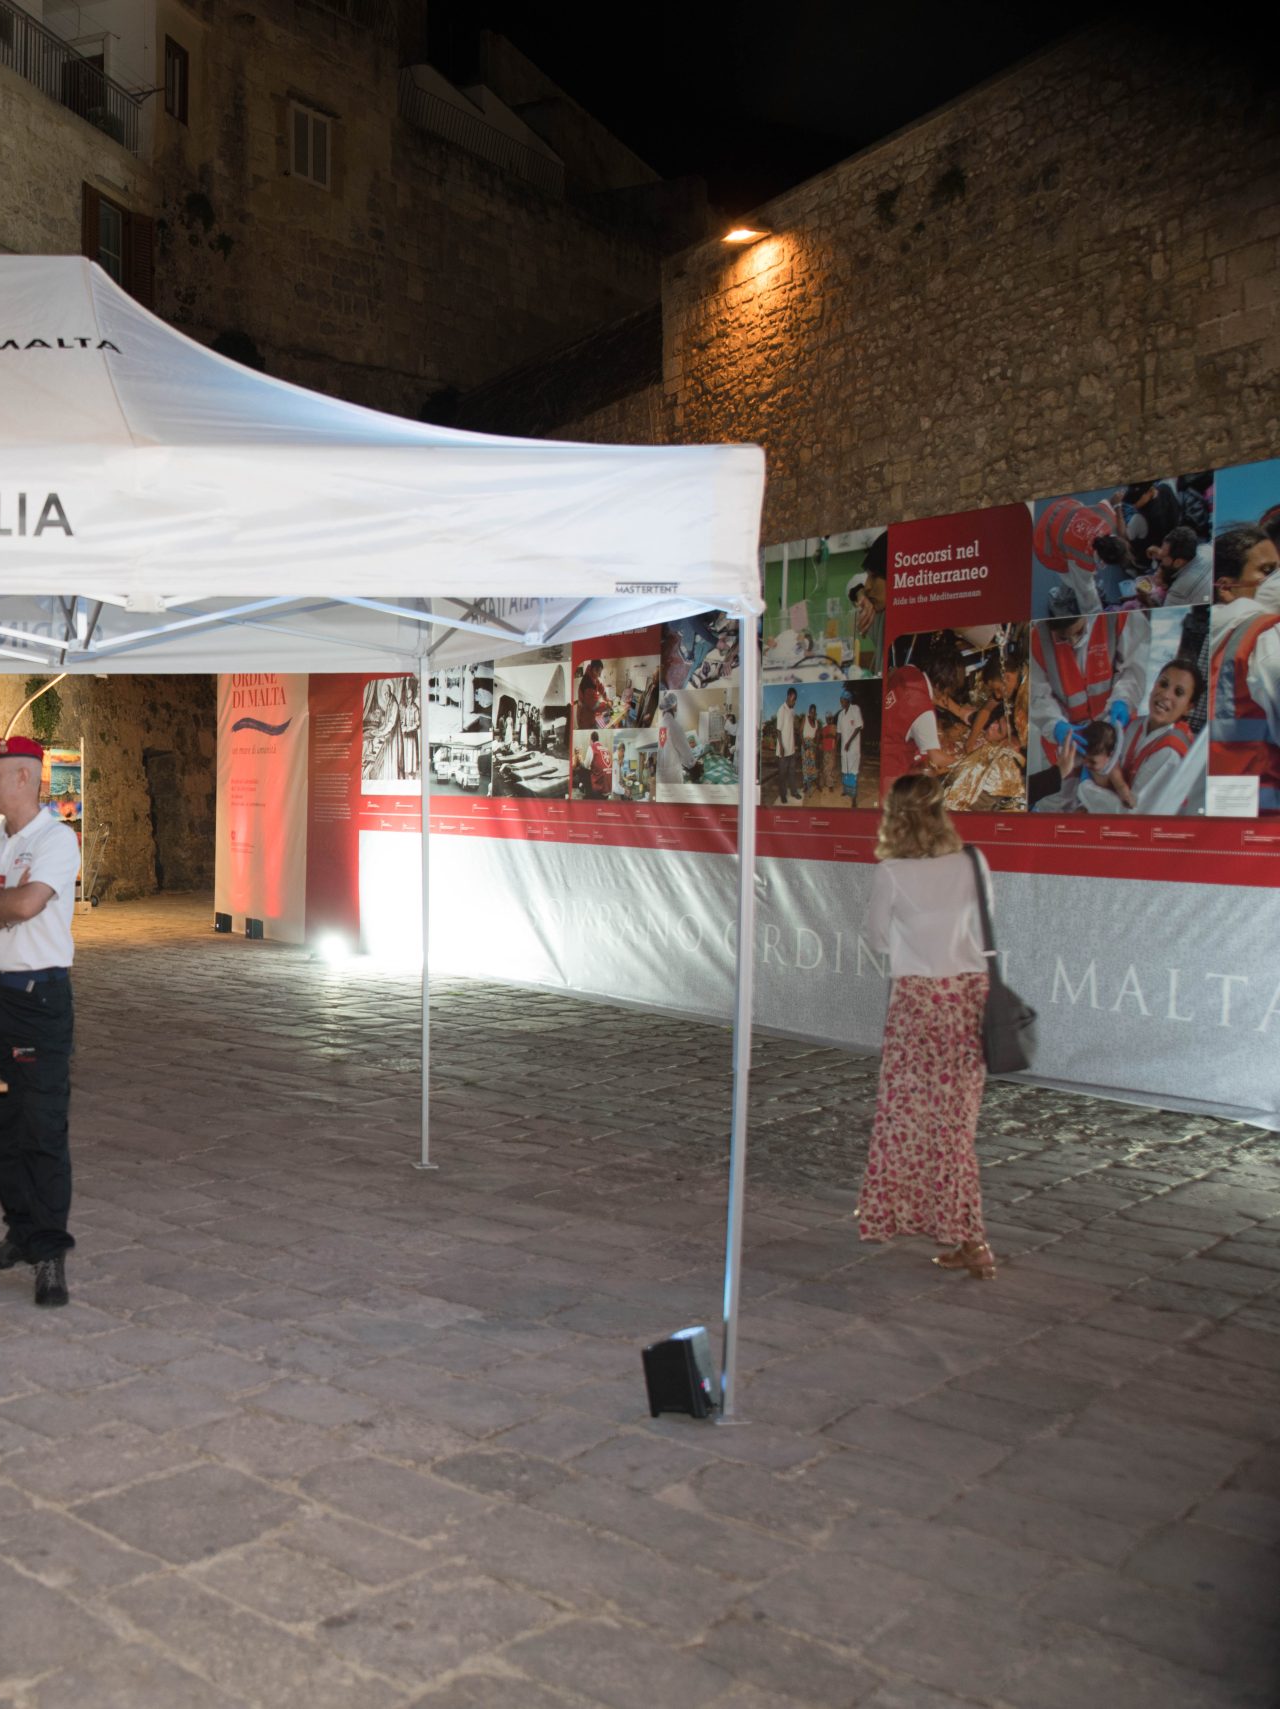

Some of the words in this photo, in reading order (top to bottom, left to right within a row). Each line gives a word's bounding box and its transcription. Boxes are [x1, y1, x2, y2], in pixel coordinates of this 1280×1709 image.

[894, 544, 952, 568] Soccorsi
[956, 539, 980, 560] nel
[893, 565, 989, 589] Mediterraneo
[615, 585, 679, 594] MASTERTENT
[917, 594, 928, 603] the
[929, 589, 982, 602] Mediterranean
[232, 673, 277, 688] ORDINE
[233, 689, 245, 708] DI
[248, 686, 287, 707] MALTA
[527, 896, 704, 952] SOVRANO
